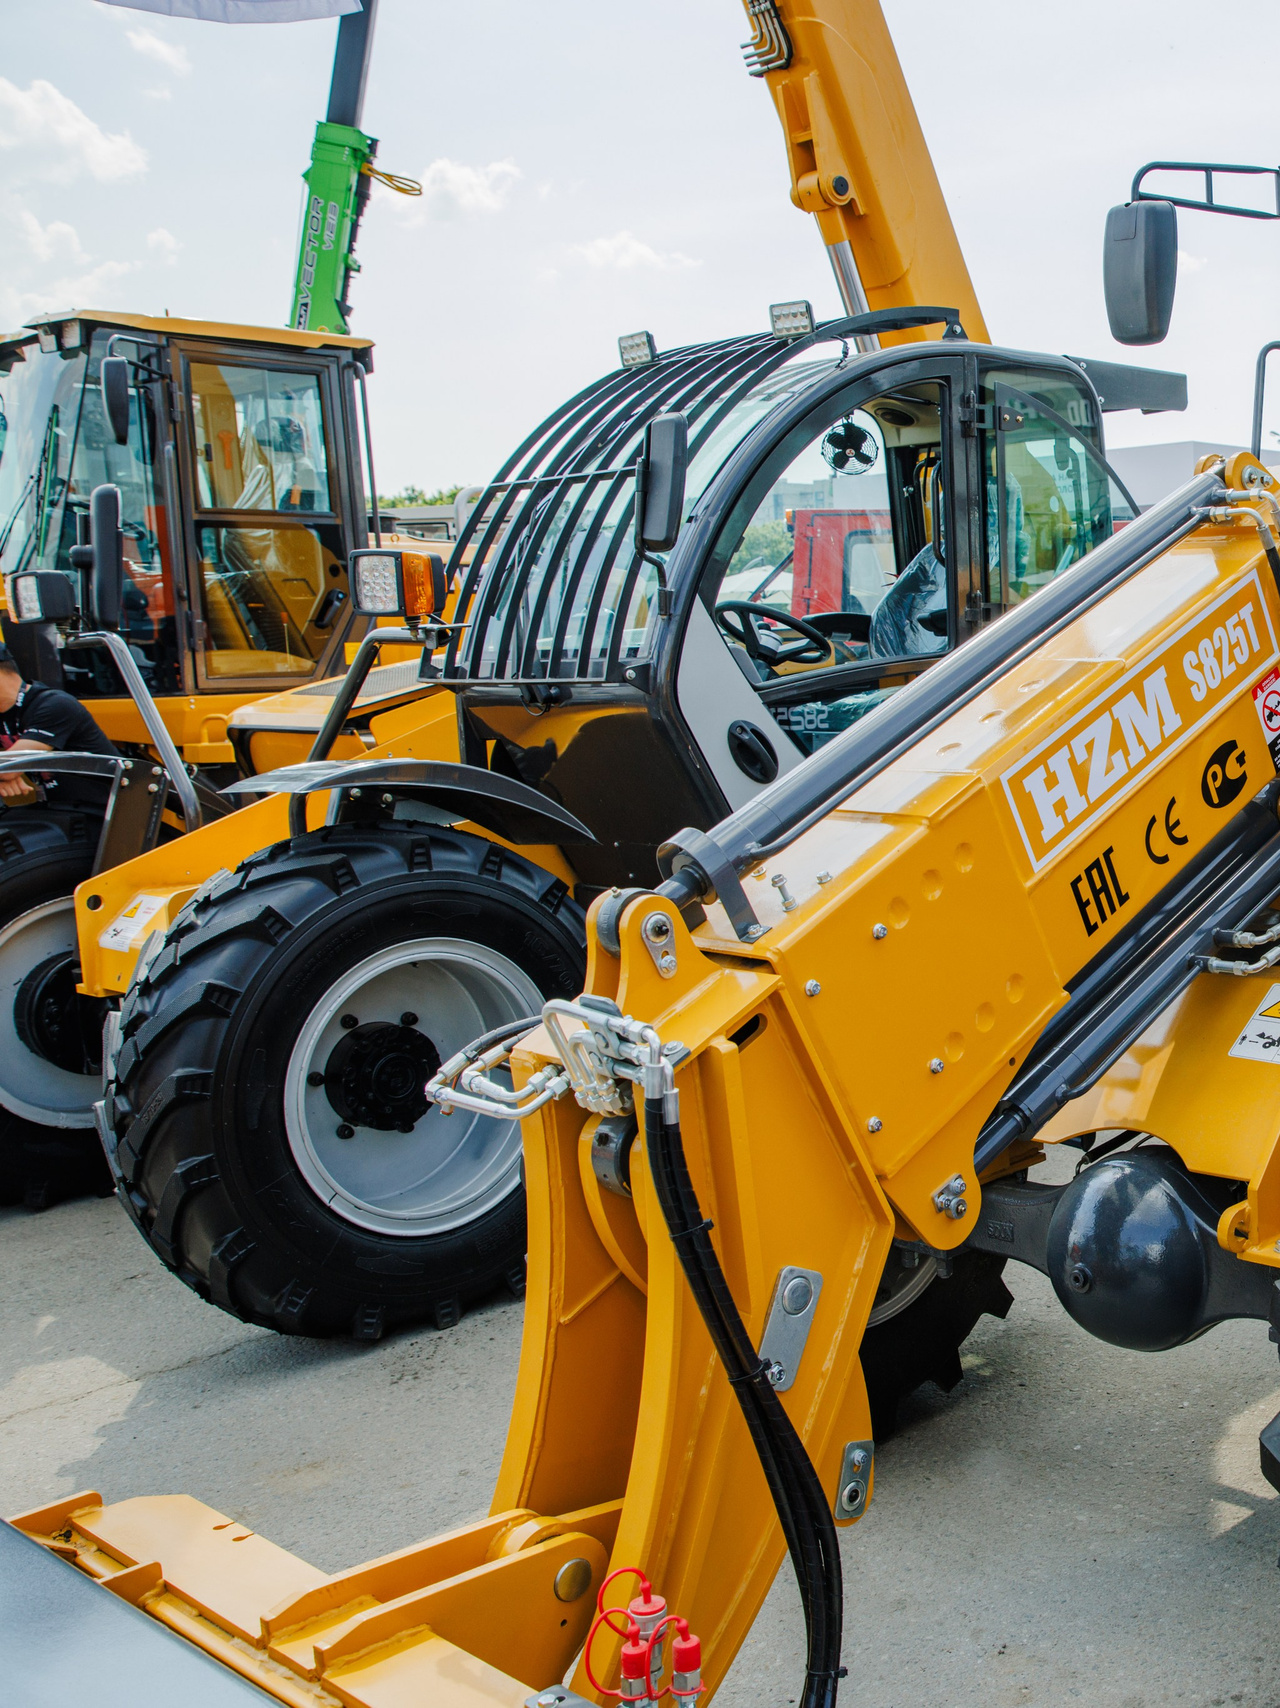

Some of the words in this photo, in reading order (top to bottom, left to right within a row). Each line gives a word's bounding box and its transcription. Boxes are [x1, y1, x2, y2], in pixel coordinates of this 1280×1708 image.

[299, 195, 325, 302] VECTOR
[1182, 602, 1261, 702] S825T
[1022, 665, 1183, 844] HZM
